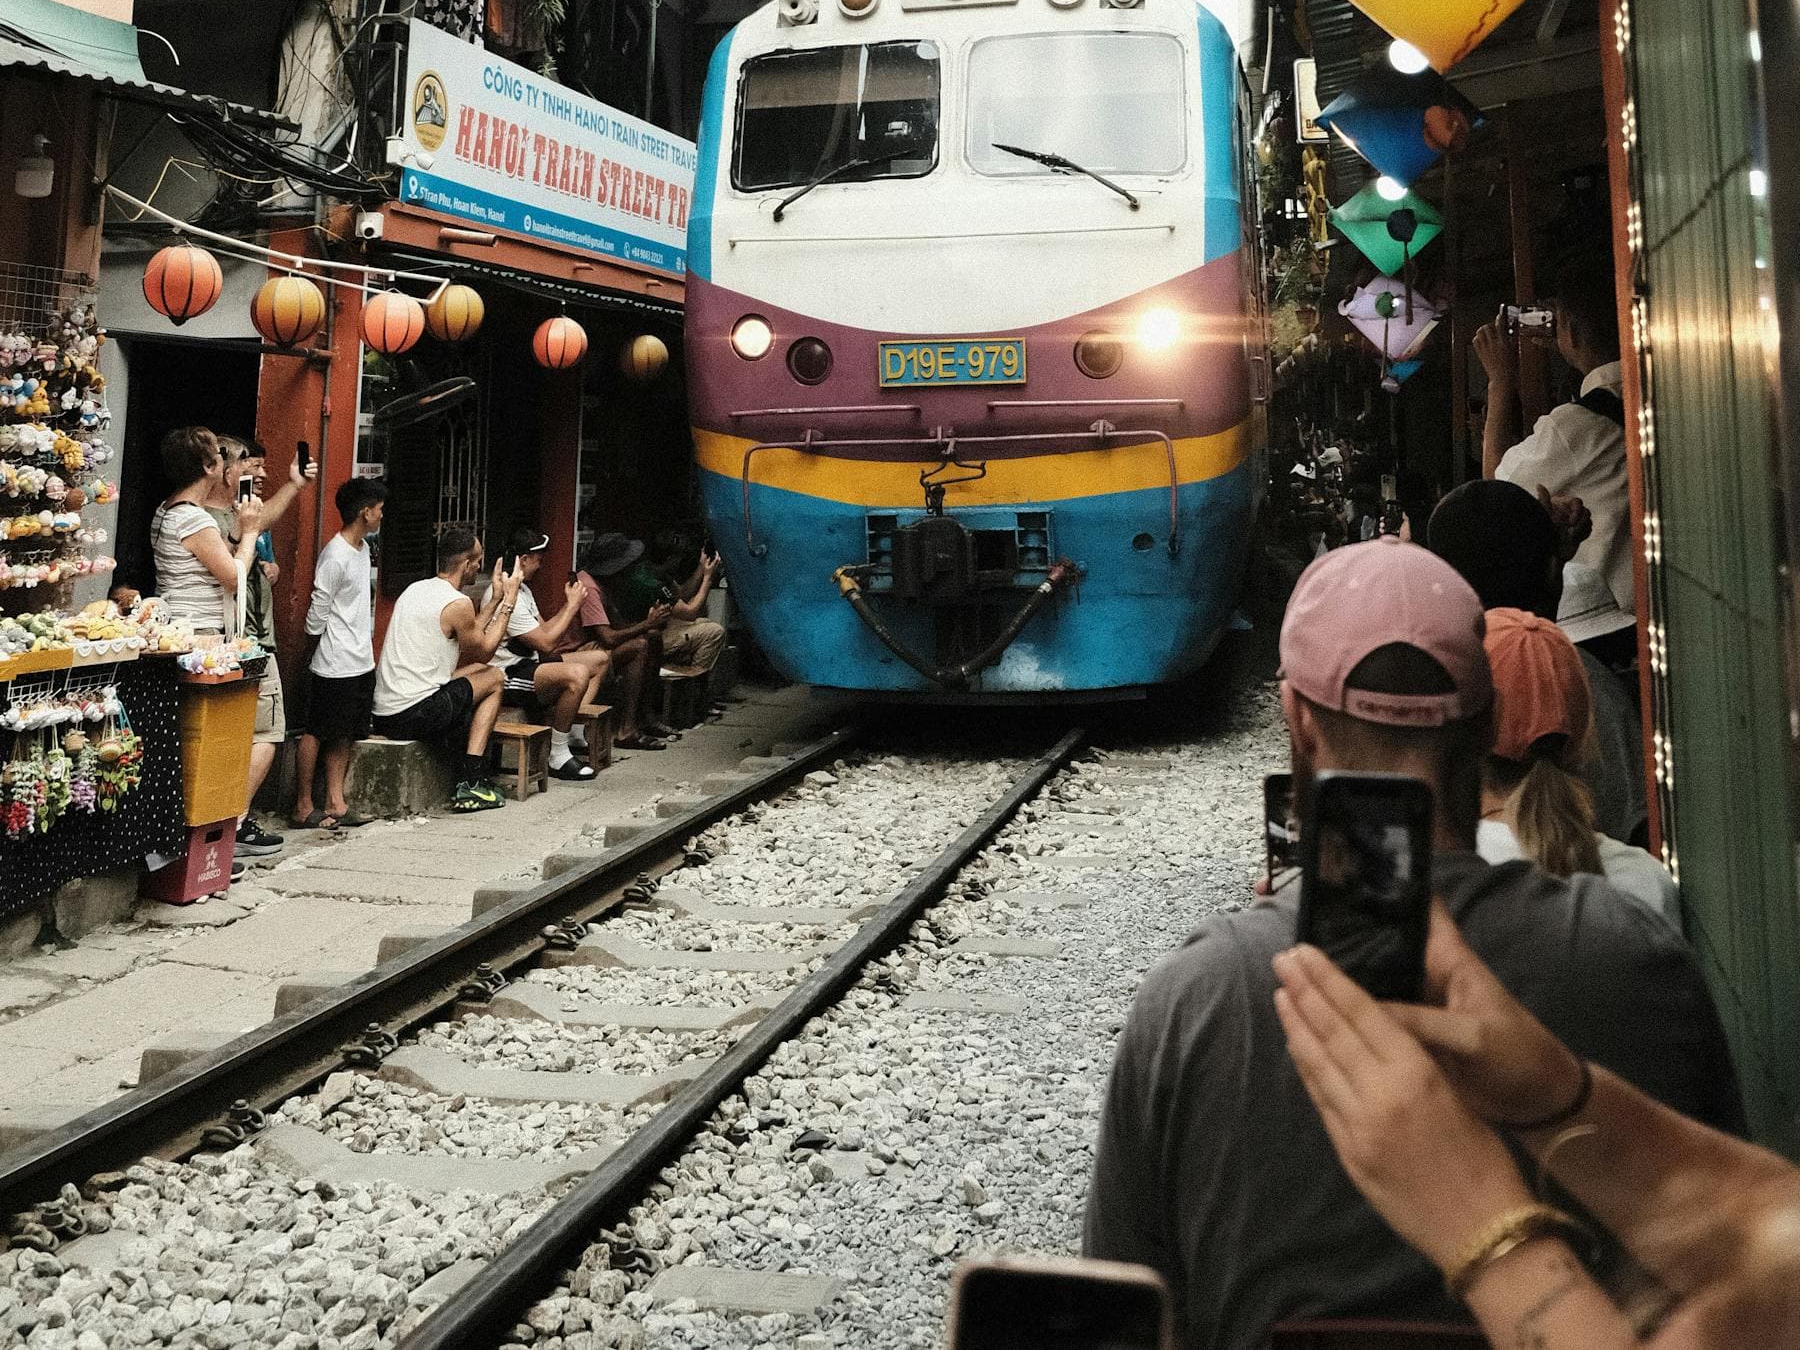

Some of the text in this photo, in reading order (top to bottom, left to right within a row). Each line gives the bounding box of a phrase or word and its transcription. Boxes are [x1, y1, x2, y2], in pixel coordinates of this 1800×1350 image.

[484, 66, 523, 101] CÔNG
[526, 84, 540, 108] TY
[543, 91, 572, 122] TNHH
[575, 106, 609, 137] HANOI
[612, 121, 639, 149] TRAIN
[641, 133, 669, 162] STREET
[488, 208, 505, 223] Hanoi
[597, 158, 665, 224] STREET
[885, 345, 1019, 380] D19E-979
